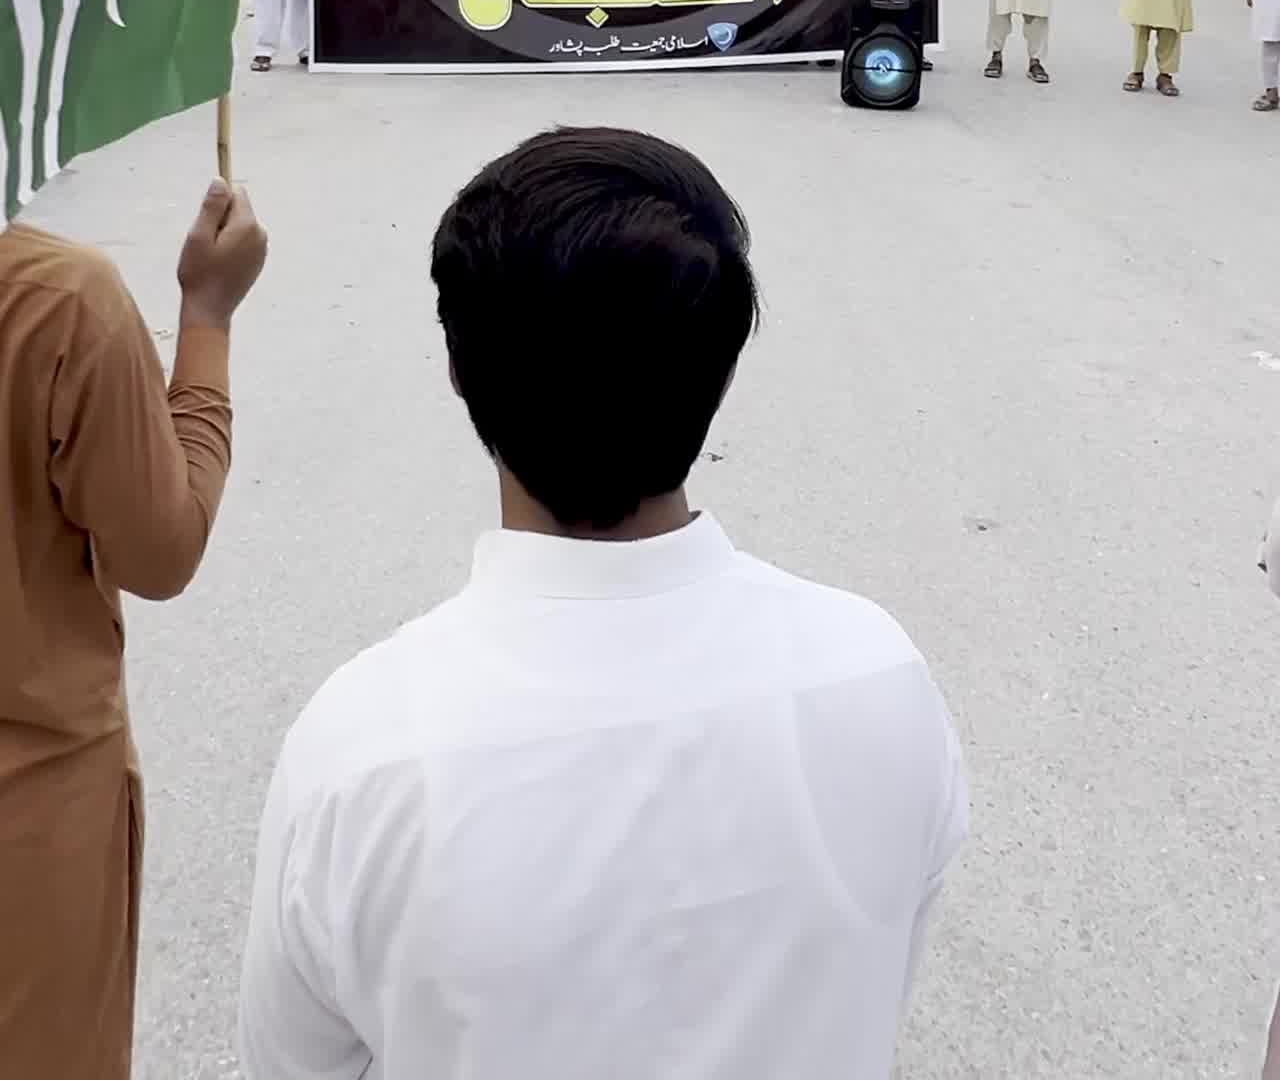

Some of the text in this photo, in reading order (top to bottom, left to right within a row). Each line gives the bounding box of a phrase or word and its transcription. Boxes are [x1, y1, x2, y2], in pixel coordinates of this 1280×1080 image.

[549, 38, 584, 56] پشاور
[621, 36, 665, 52] جمعیت
[665, 35, 708, 52] اسلامی
